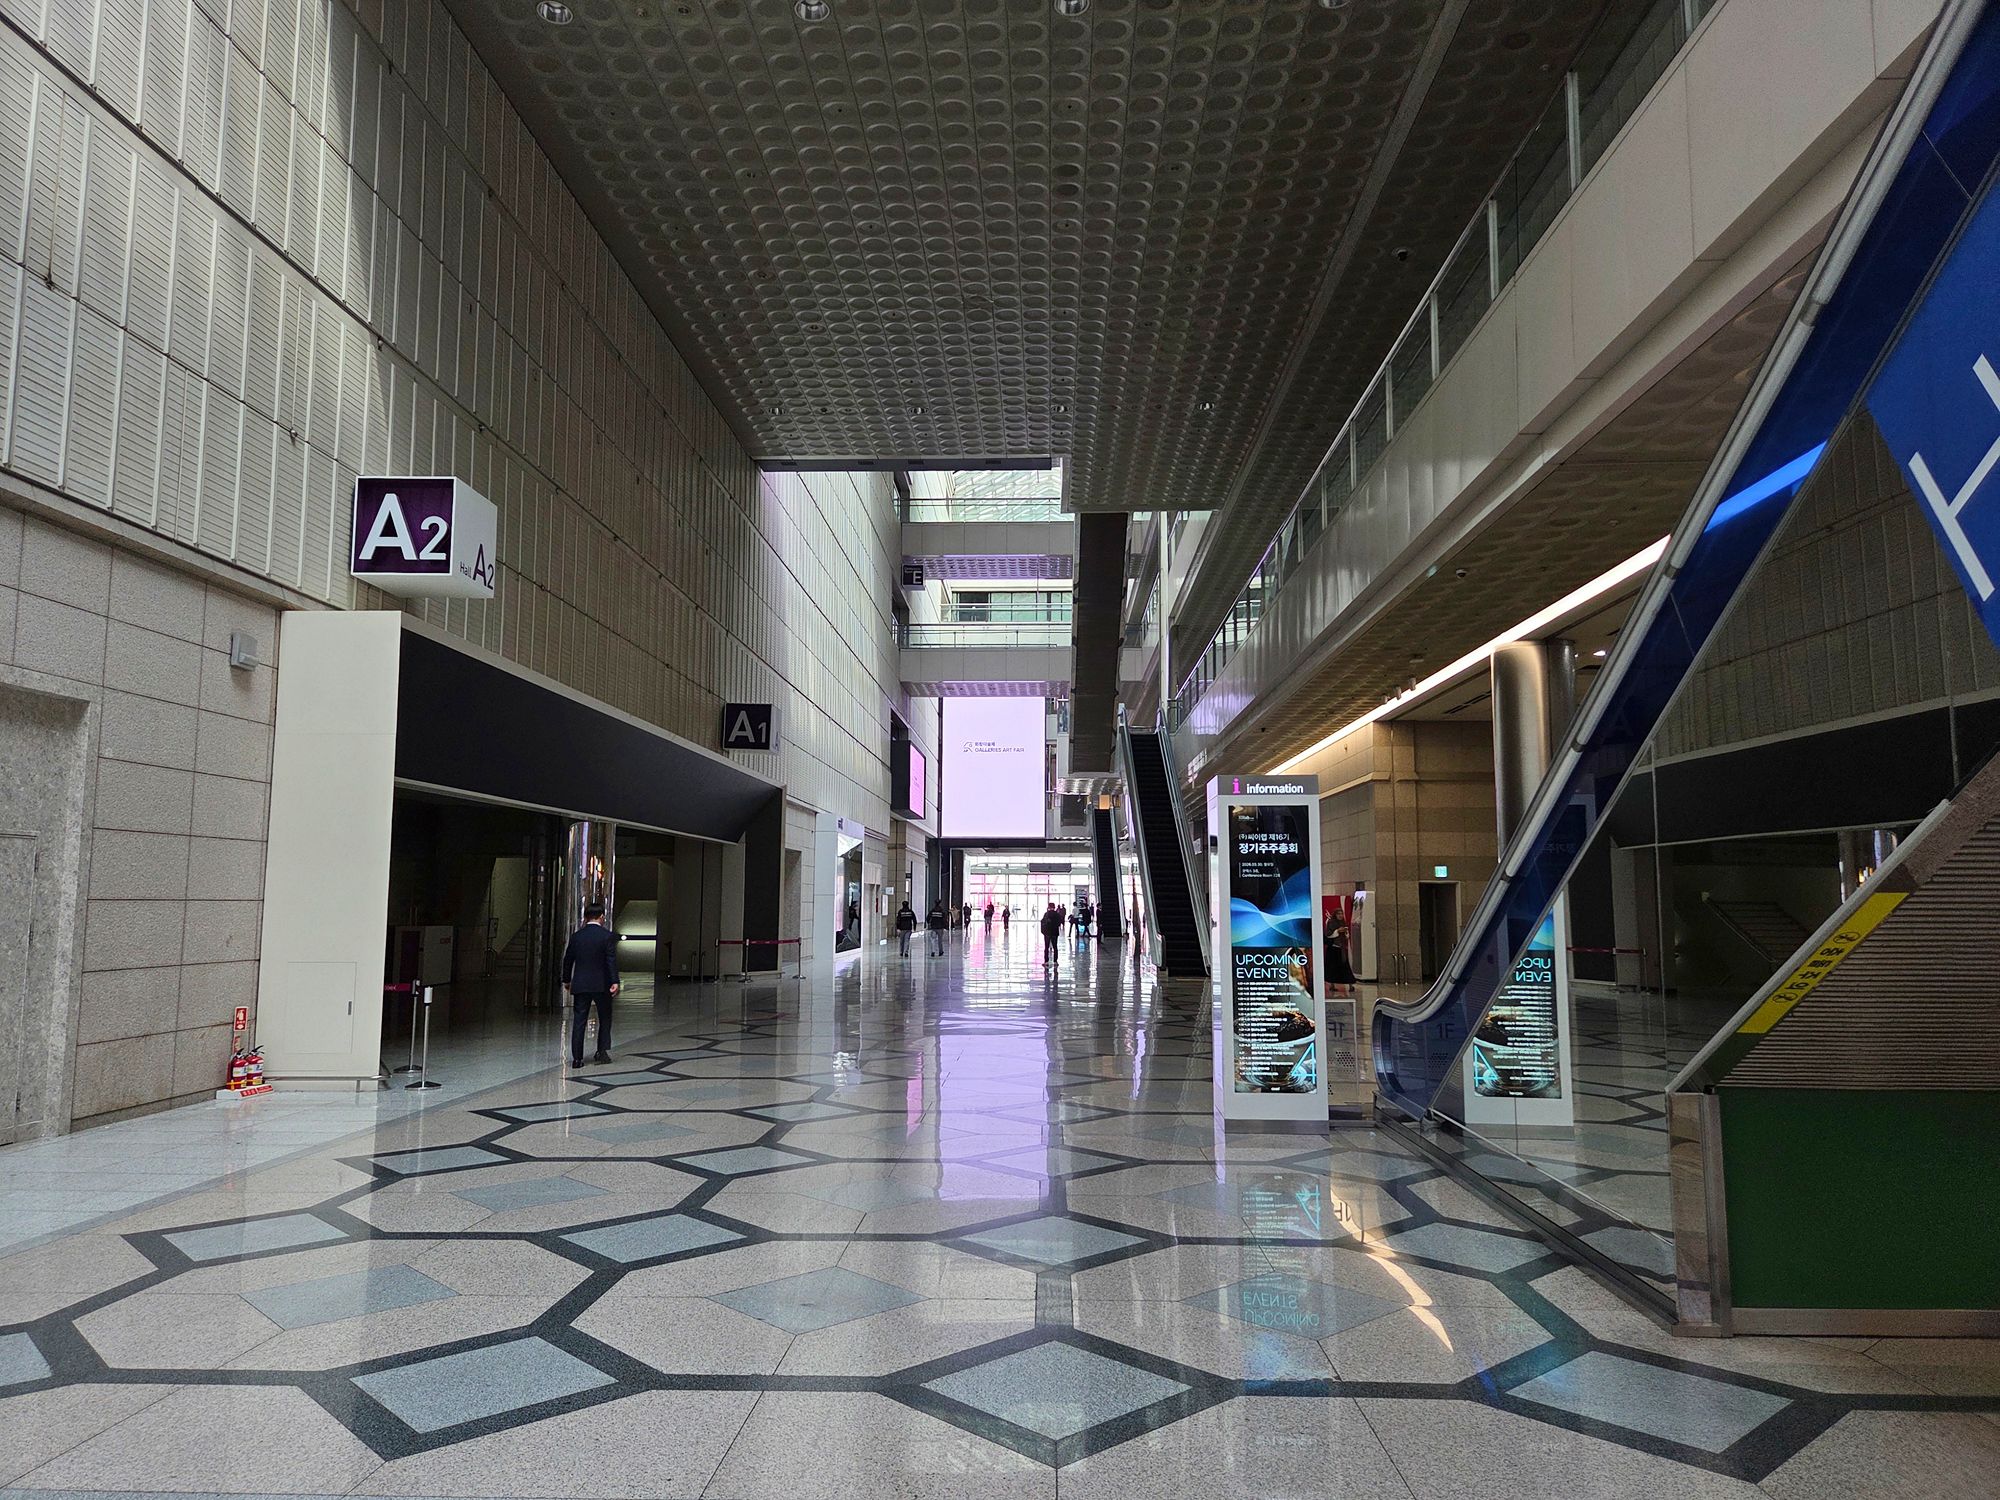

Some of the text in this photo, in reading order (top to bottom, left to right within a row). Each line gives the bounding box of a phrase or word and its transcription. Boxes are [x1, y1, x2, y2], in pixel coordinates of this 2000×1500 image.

[358, 492, 448, 561] A2
[459, 543, 495, 590] Hall A2
[913, 570, 922, 584] E
[728, 710, 767, 743] A1
[1246, 783, 1304, 794] information
[1238, 842, 1298, 855] 정기주주총회
[1235, 954, 1308, 966] UPCOMING
[1236, 967, 1288, 979] EVENTS
[1784, 947, 1846, 990] 충돌주의
